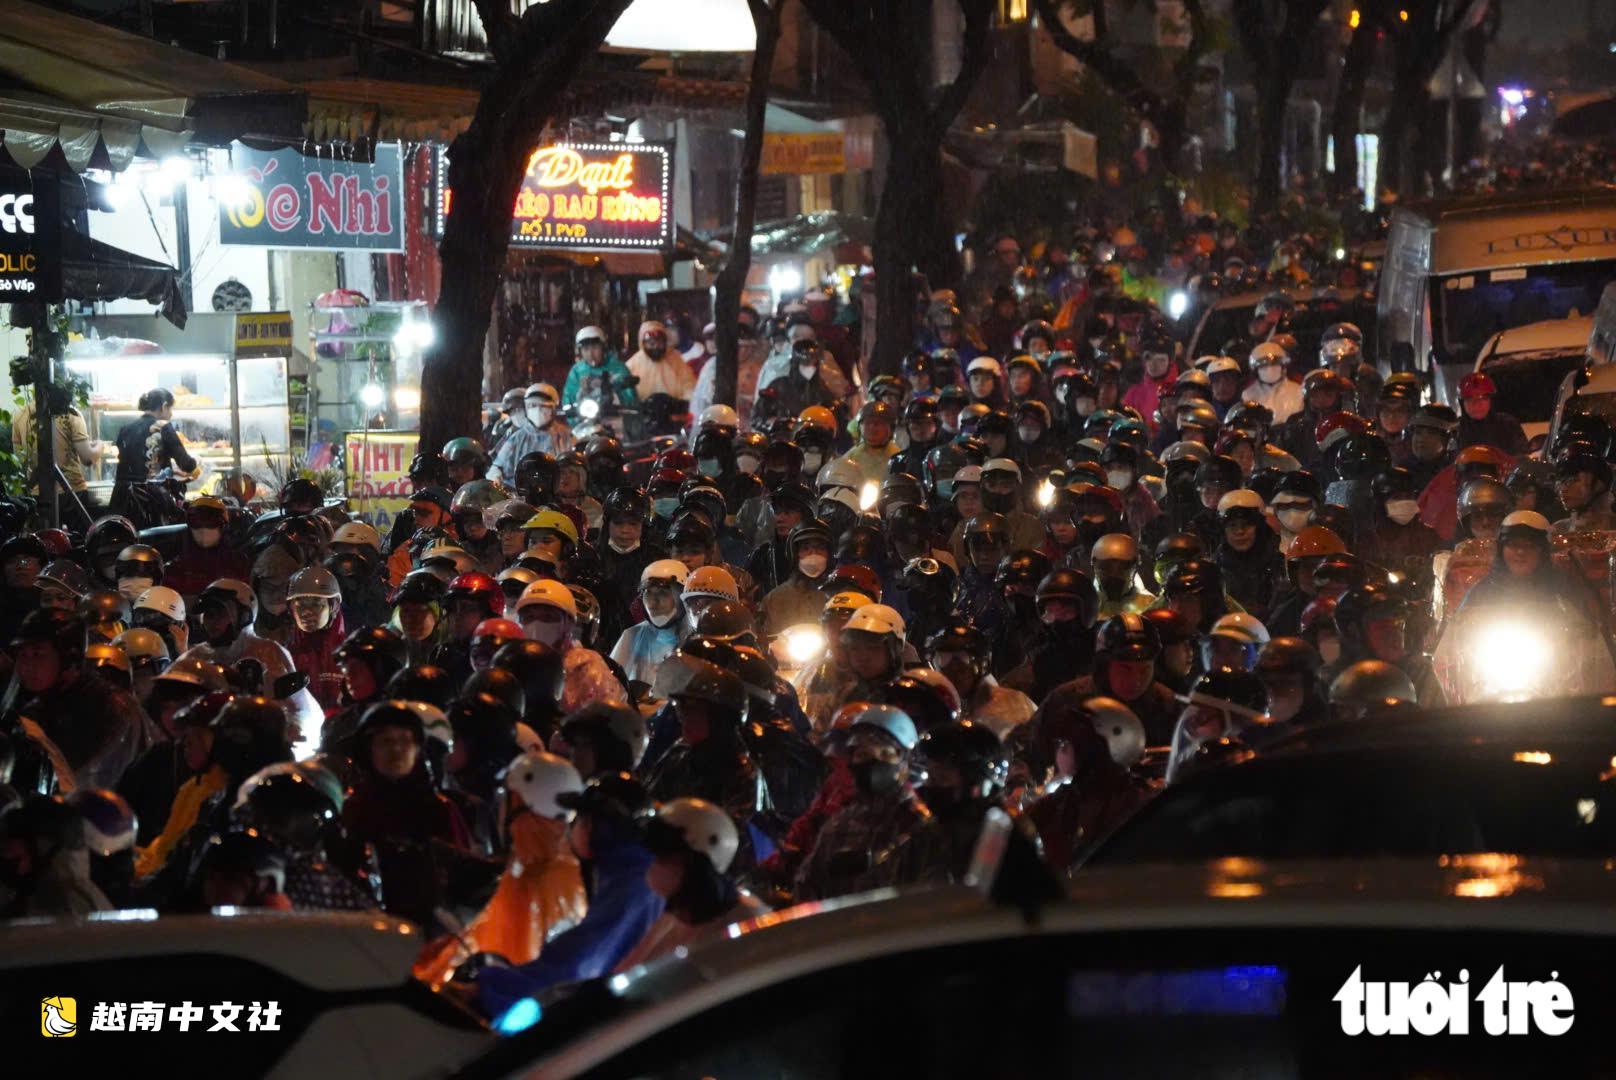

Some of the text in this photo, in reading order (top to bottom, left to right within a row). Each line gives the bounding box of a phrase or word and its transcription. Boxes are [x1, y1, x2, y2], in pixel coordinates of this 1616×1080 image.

[306, 172, 393, 235] Nhi
[552, 194, 598, 220] RAU
[544, 222, 552, 237] 1
[12, 278, 36, 293] Vấp
